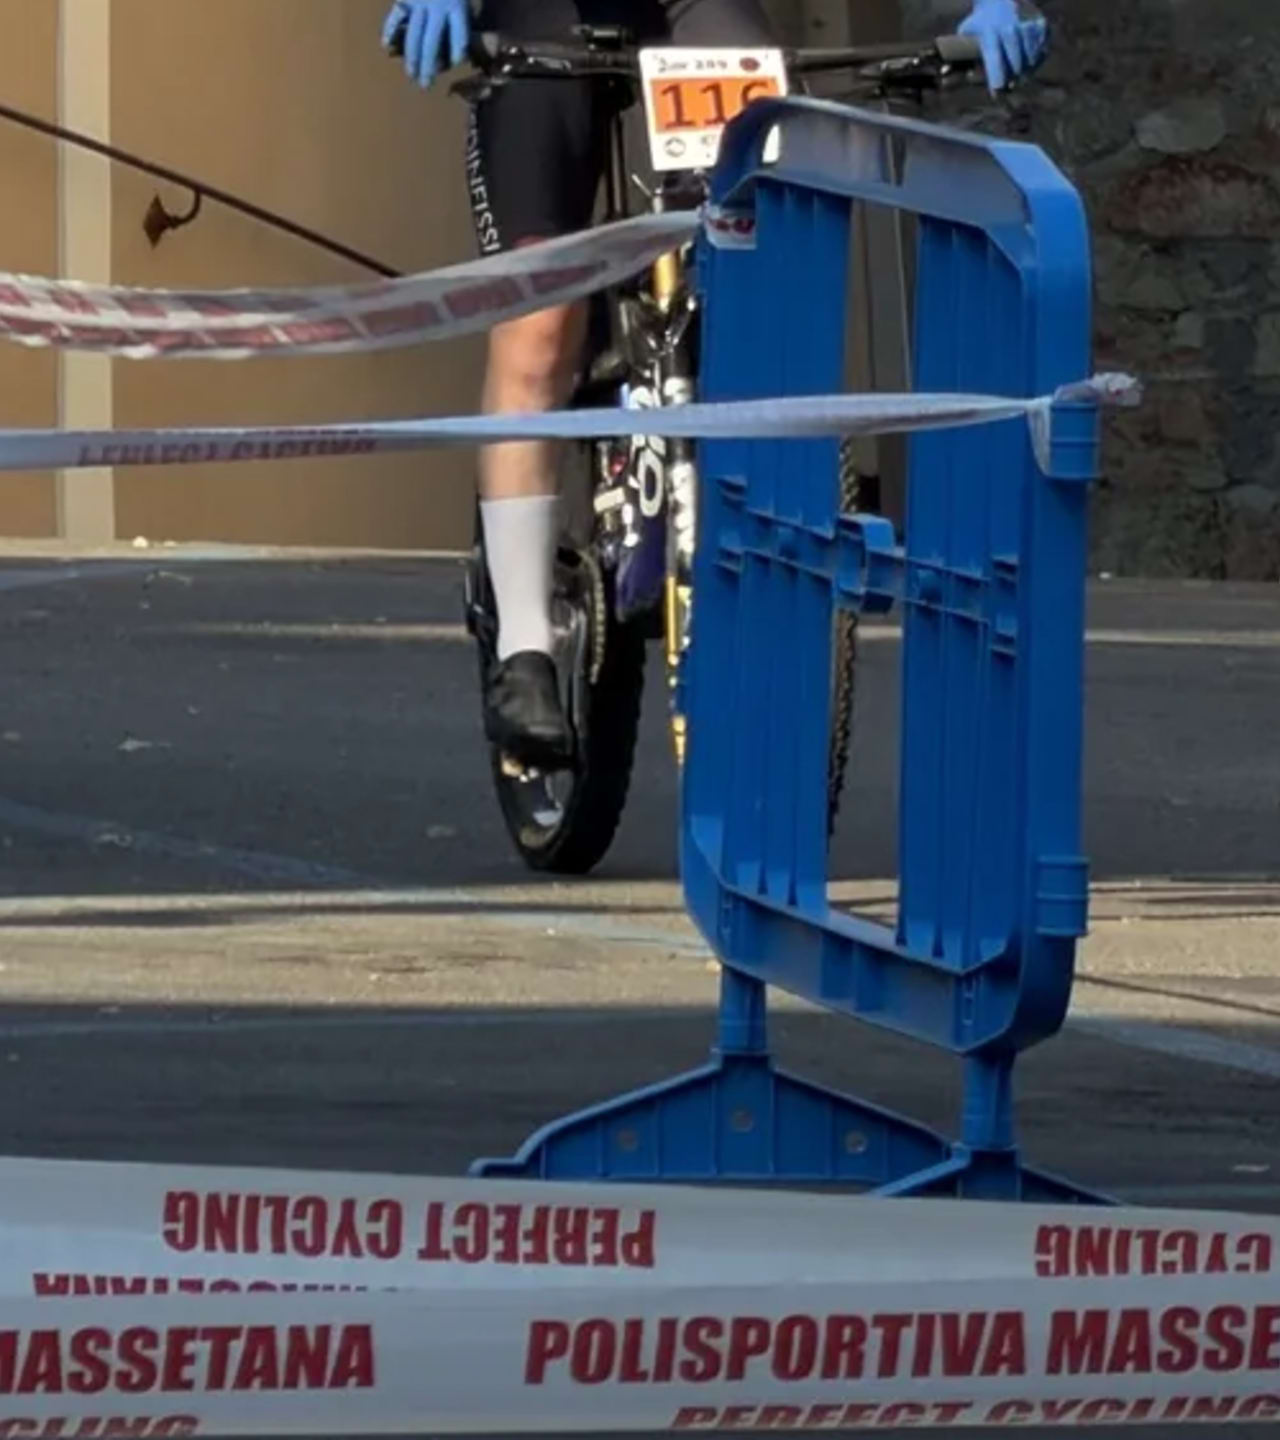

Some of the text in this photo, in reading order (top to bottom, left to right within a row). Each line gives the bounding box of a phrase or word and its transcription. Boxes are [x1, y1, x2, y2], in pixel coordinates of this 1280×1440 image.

[163, 1189, 658, 1267] PERFECT CYCLING
[1033, 1224, 1273, 1278] CYCLING
[524, 1310, 1026, 1385] POLISPORTIVA
